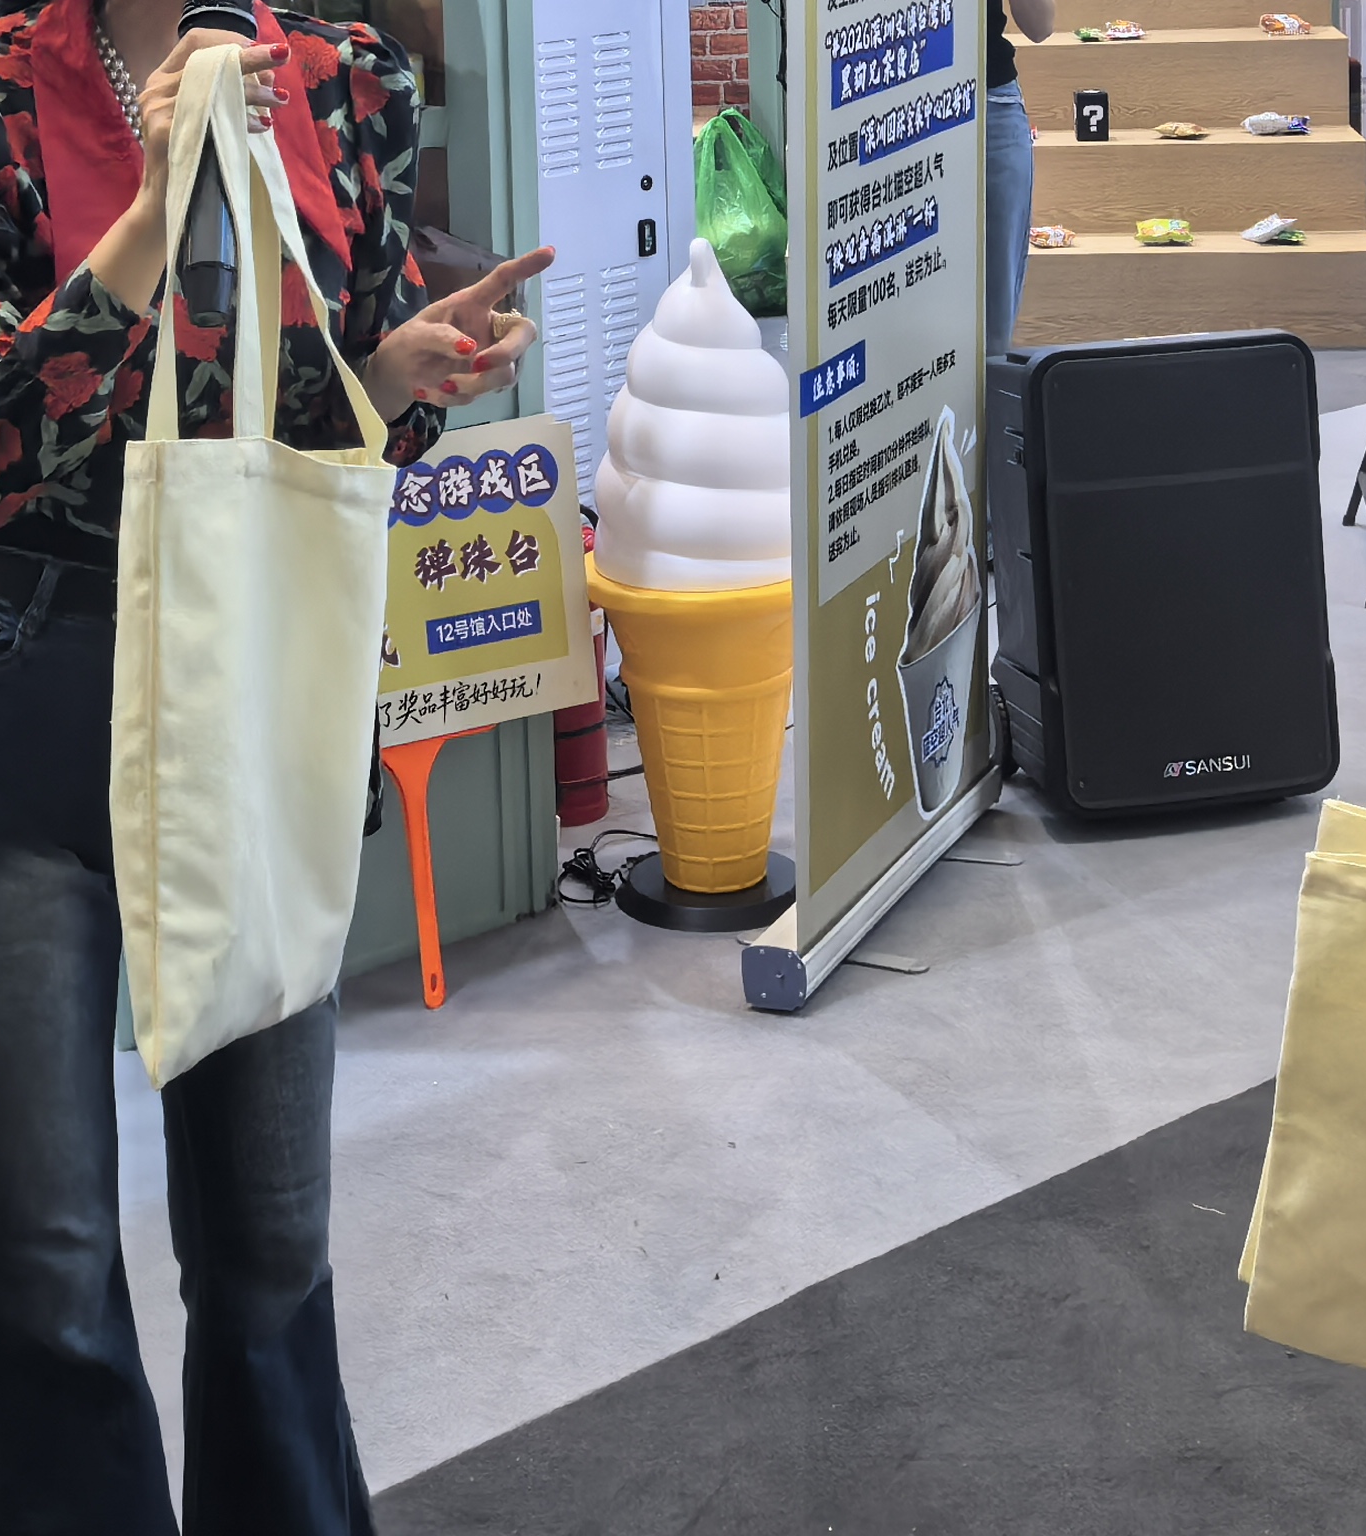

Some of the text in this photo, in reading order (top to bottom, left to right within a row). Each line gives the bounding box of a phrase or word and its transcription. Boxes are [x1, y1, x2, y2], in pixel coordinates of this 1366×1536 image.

[389, 453, 551, 514] 念游戏区
[435, 607, 533, 644] 12号馆入口处
[865, 591, 895, 801] ice cream
[1185, 754, 1251, 776] SANSUI
